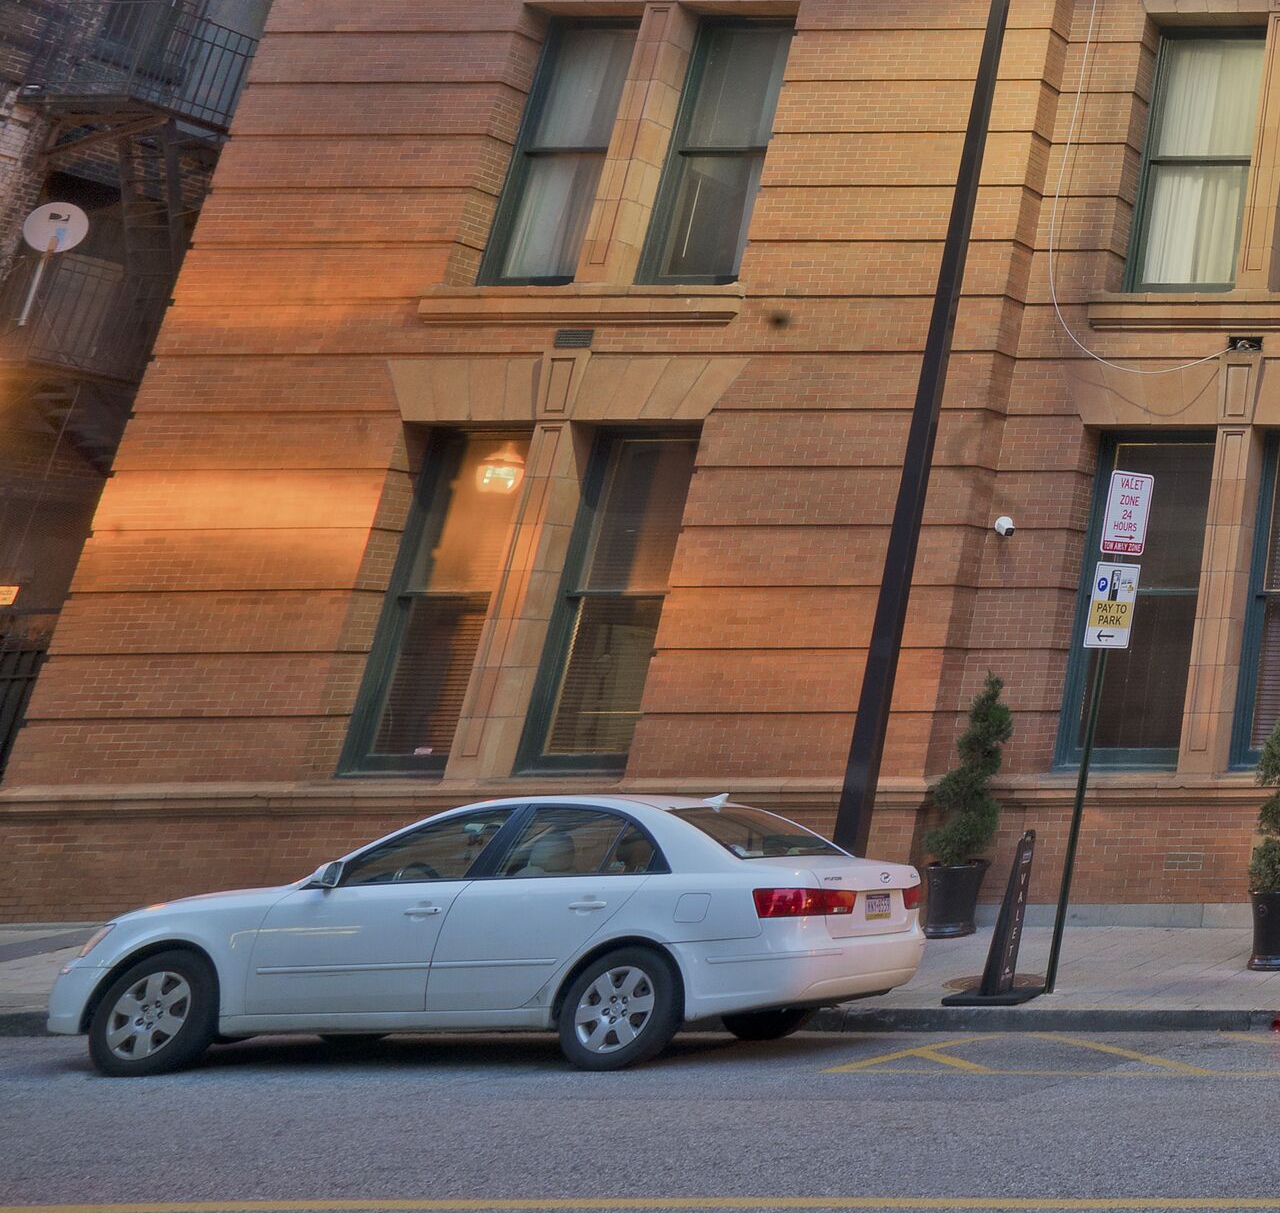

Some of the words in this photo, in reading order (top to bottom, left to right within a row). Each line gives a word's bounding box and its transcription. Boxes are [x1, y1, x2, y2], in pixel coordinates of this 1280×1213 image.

[1120, 477, 1144, 490] VALET
[1119, 494, 1140, 506] ZONE
[1122, 509, 1132, 519] 24
[1113, 521, 1137, 532] HOURS
[1104, 541, 1114, 550] TOW
[1114, 542, 1128, 551] AWAY
[1128, 543, 1142, 552] ZONE
[1097, 603, 1113, 613] PAY
[1116, 604, 1127, 614] TO
[1098, 615, 1121, 625] PARK
[1008, 873, 1026, 957] VALET
